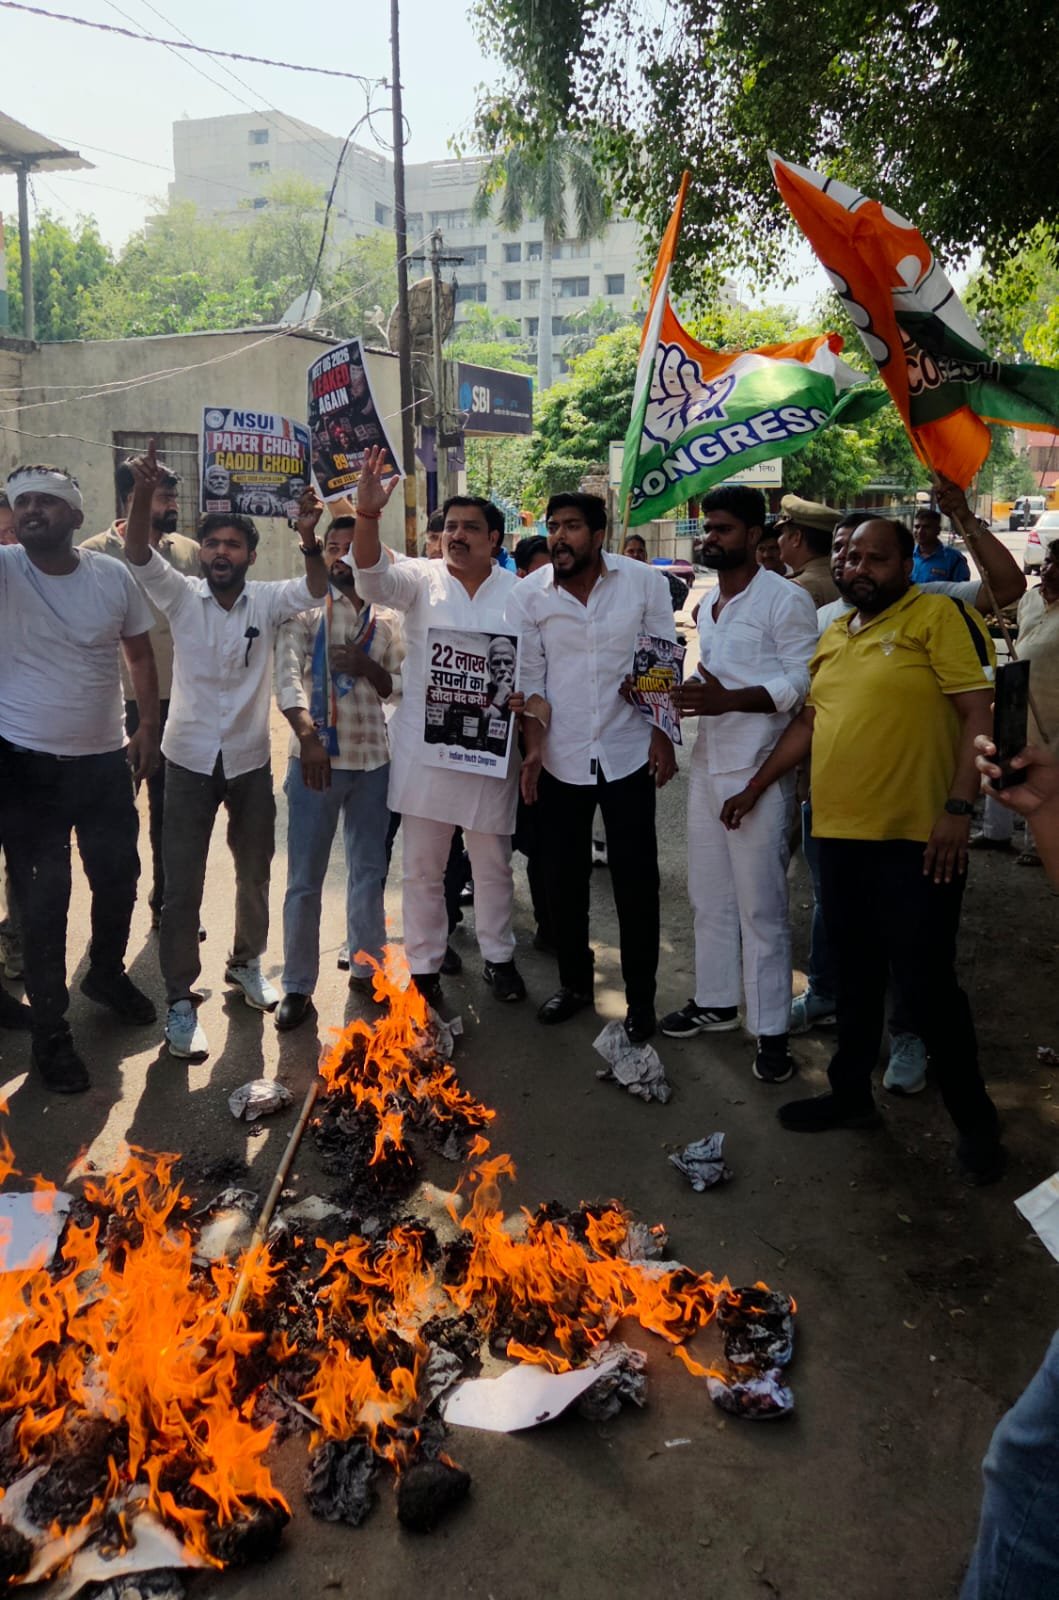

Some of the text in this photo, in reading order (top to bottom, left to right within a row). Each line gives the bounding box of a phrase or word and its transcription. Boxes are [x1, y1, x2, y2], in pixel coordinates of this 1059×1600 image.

[312, 364, 351, 399] LEAKED
[319, 386, 350, 415] AGAIN
[472, 385, 490, 413] SBI
[233, 411, 274, 430] NSUI
[213, 432, 259, 453] PAPER
[262, 436, 300, 458] CHOR
[215, 451, 259, 471] GADDI
[333, 453, 349, 472] 89
[431, 642, 486, 674] 22 लाख
[431, 669, 485, 692] सपनों का
